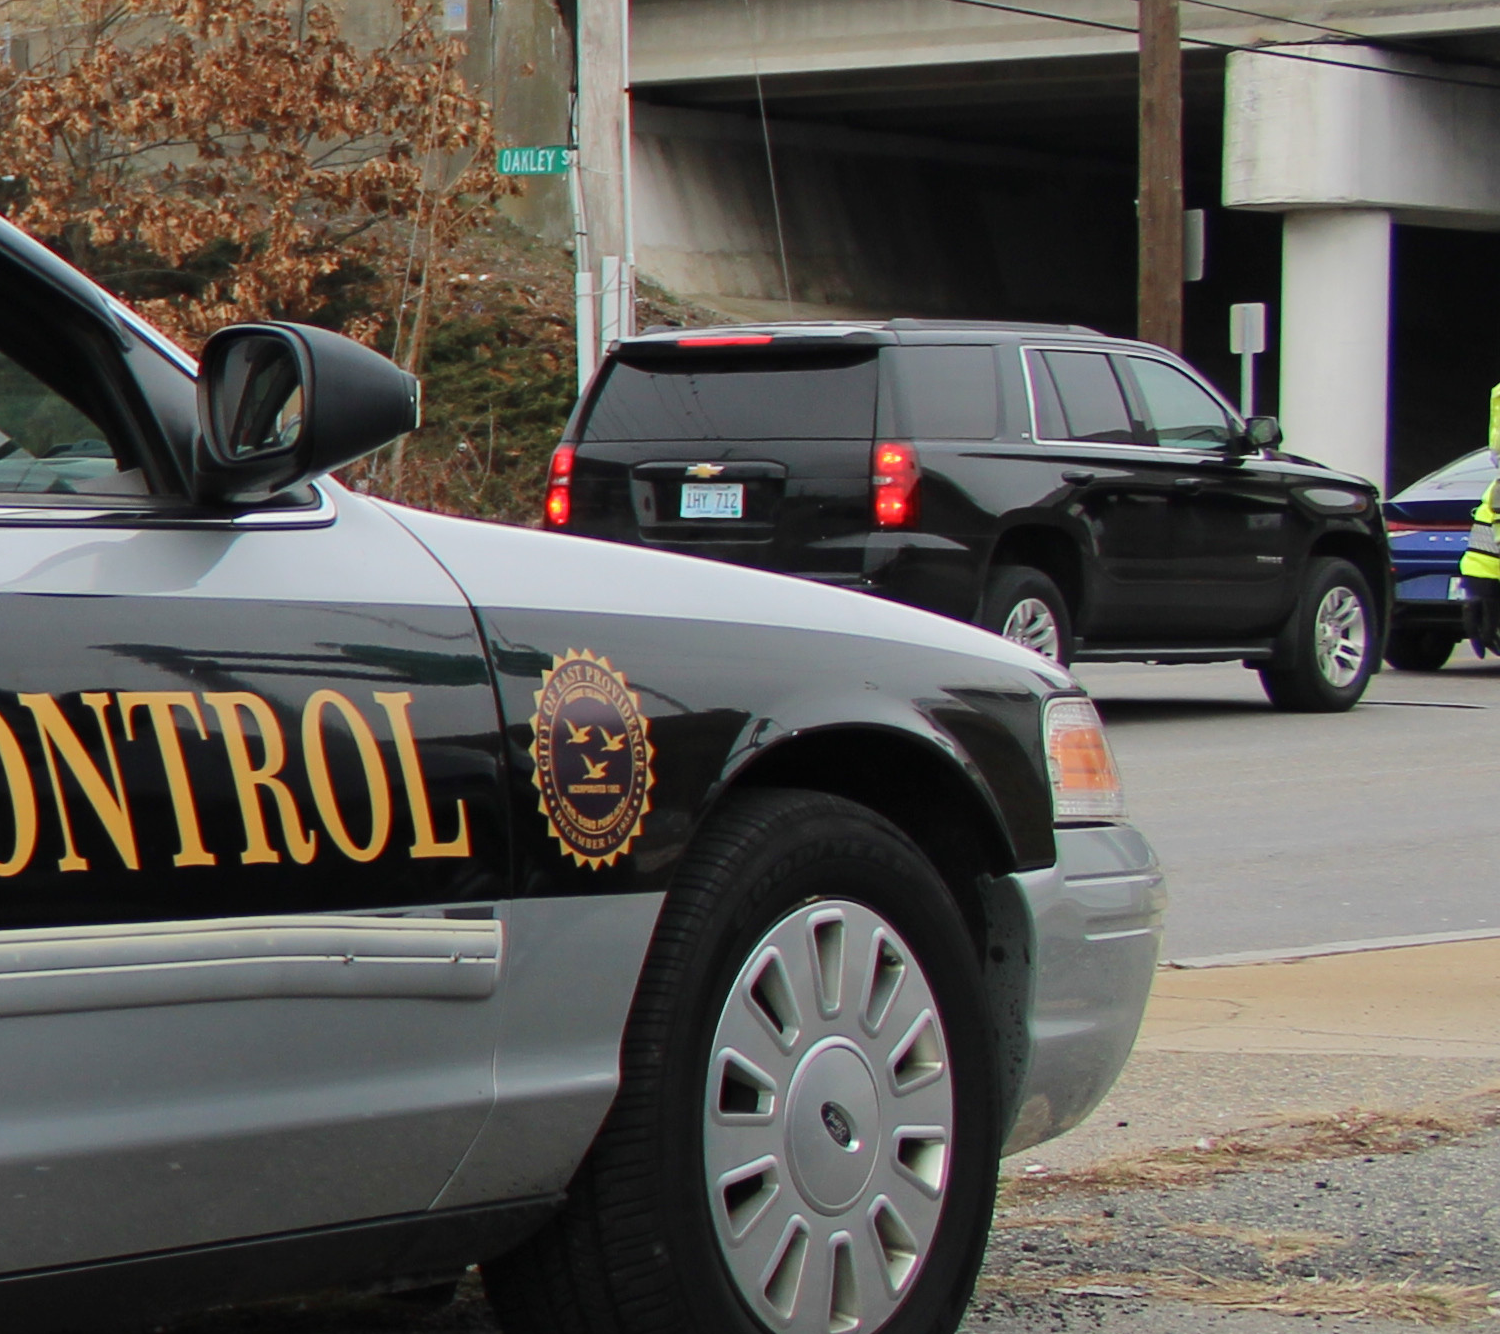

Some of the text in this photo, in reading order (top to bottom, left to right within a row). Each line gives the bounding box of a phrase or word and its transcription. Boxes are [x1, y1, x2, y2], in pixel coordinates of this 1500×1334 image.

[502, 149, 556, 172] OAKLEY
[716, 493, 738, 508] 712
[554, 665, 582, 692] EAST
[543, 690, 559, 716] OF
[585, 665, 646, 771] PROVIDENCE
[539, 720, 552, 772] CITY
[554, 809, 606, 849] DECEMBER
